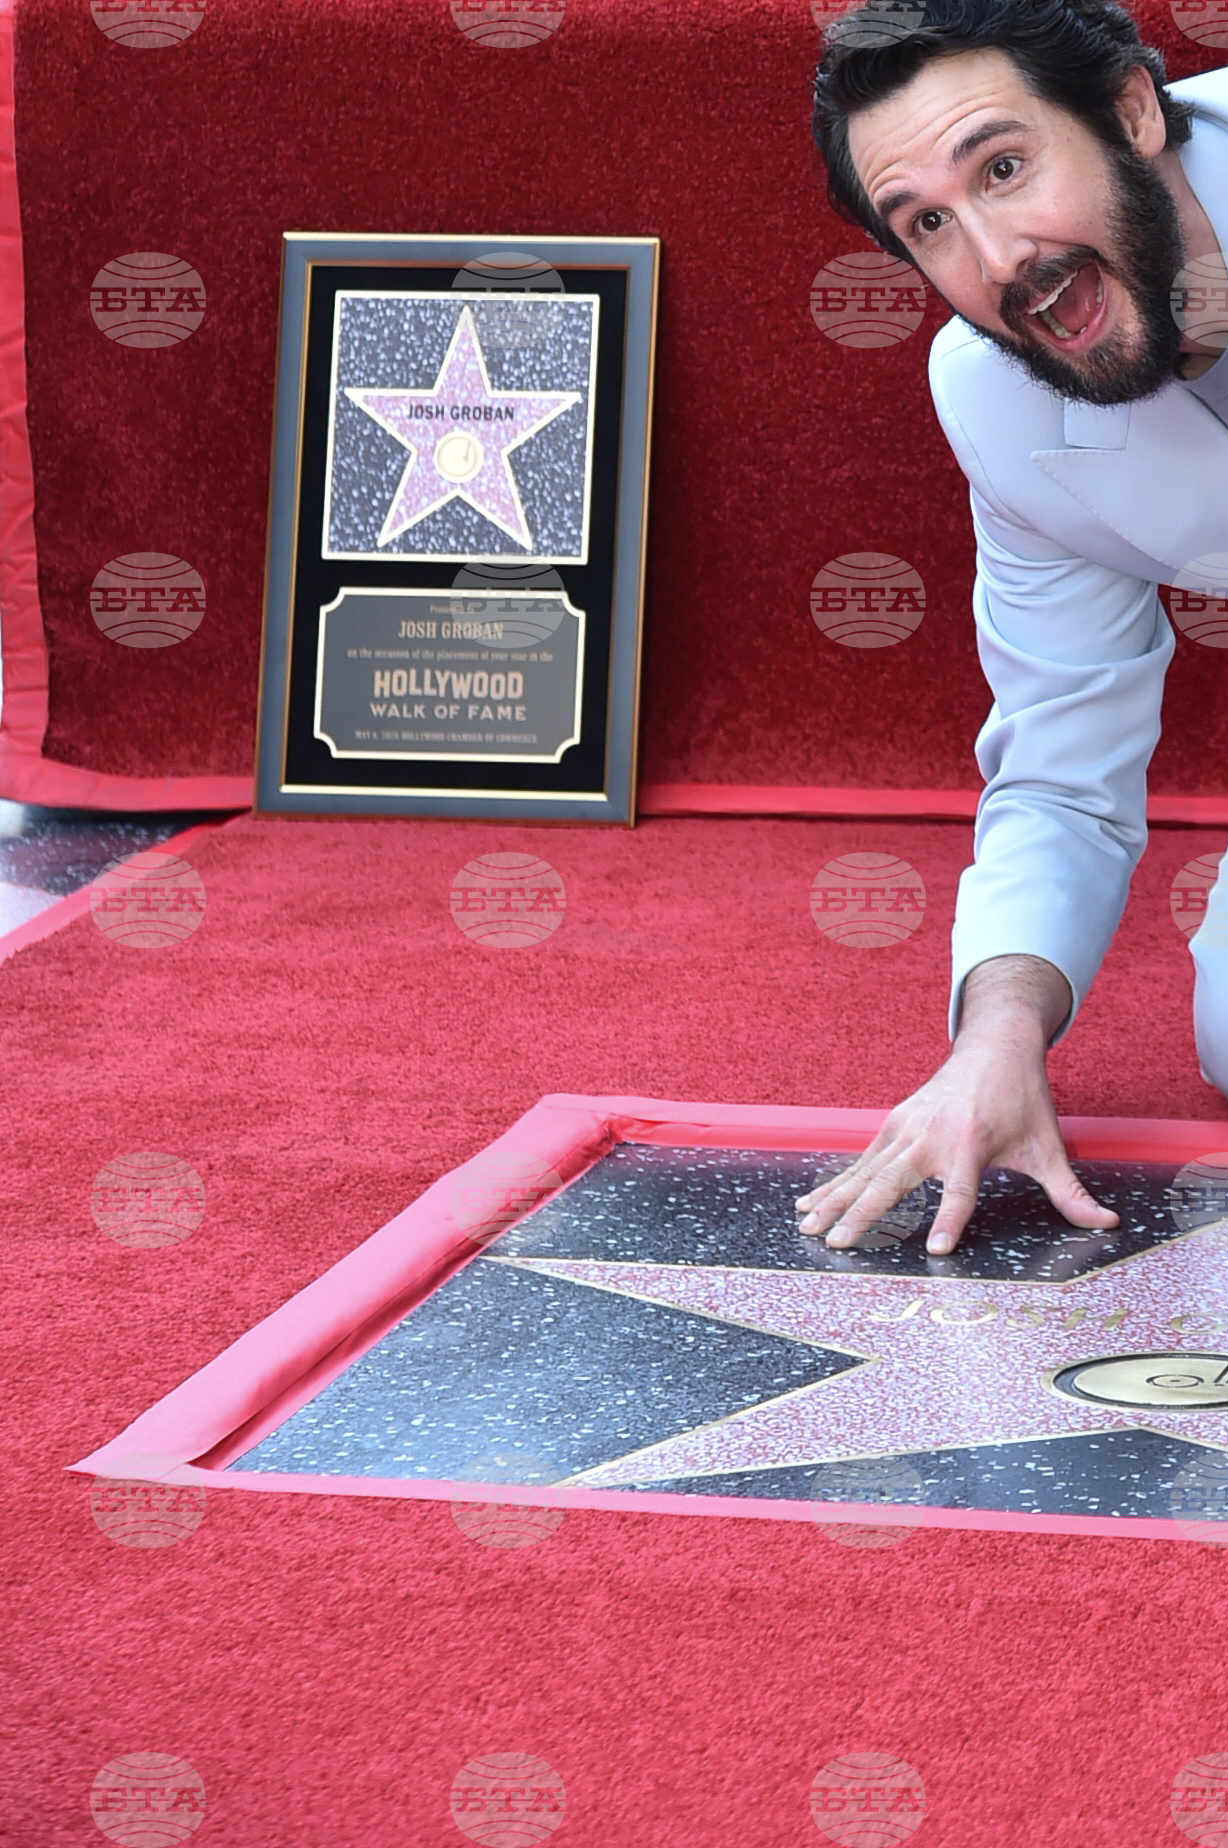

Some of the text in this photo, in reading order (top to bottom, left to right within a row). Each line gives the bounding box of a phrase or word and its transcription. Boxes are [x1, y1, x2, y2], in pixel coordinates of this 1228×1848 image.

[407, 404, 514, 422] JOSH GROBAN
[398, 620, 504, 640] JOSH GROBAN
[373, 668, 524, 700] HOLLYWOOD
[369, 703, 527, 721] WALK OF FAME
[867, 1299, 1131, 1332] JOSH
